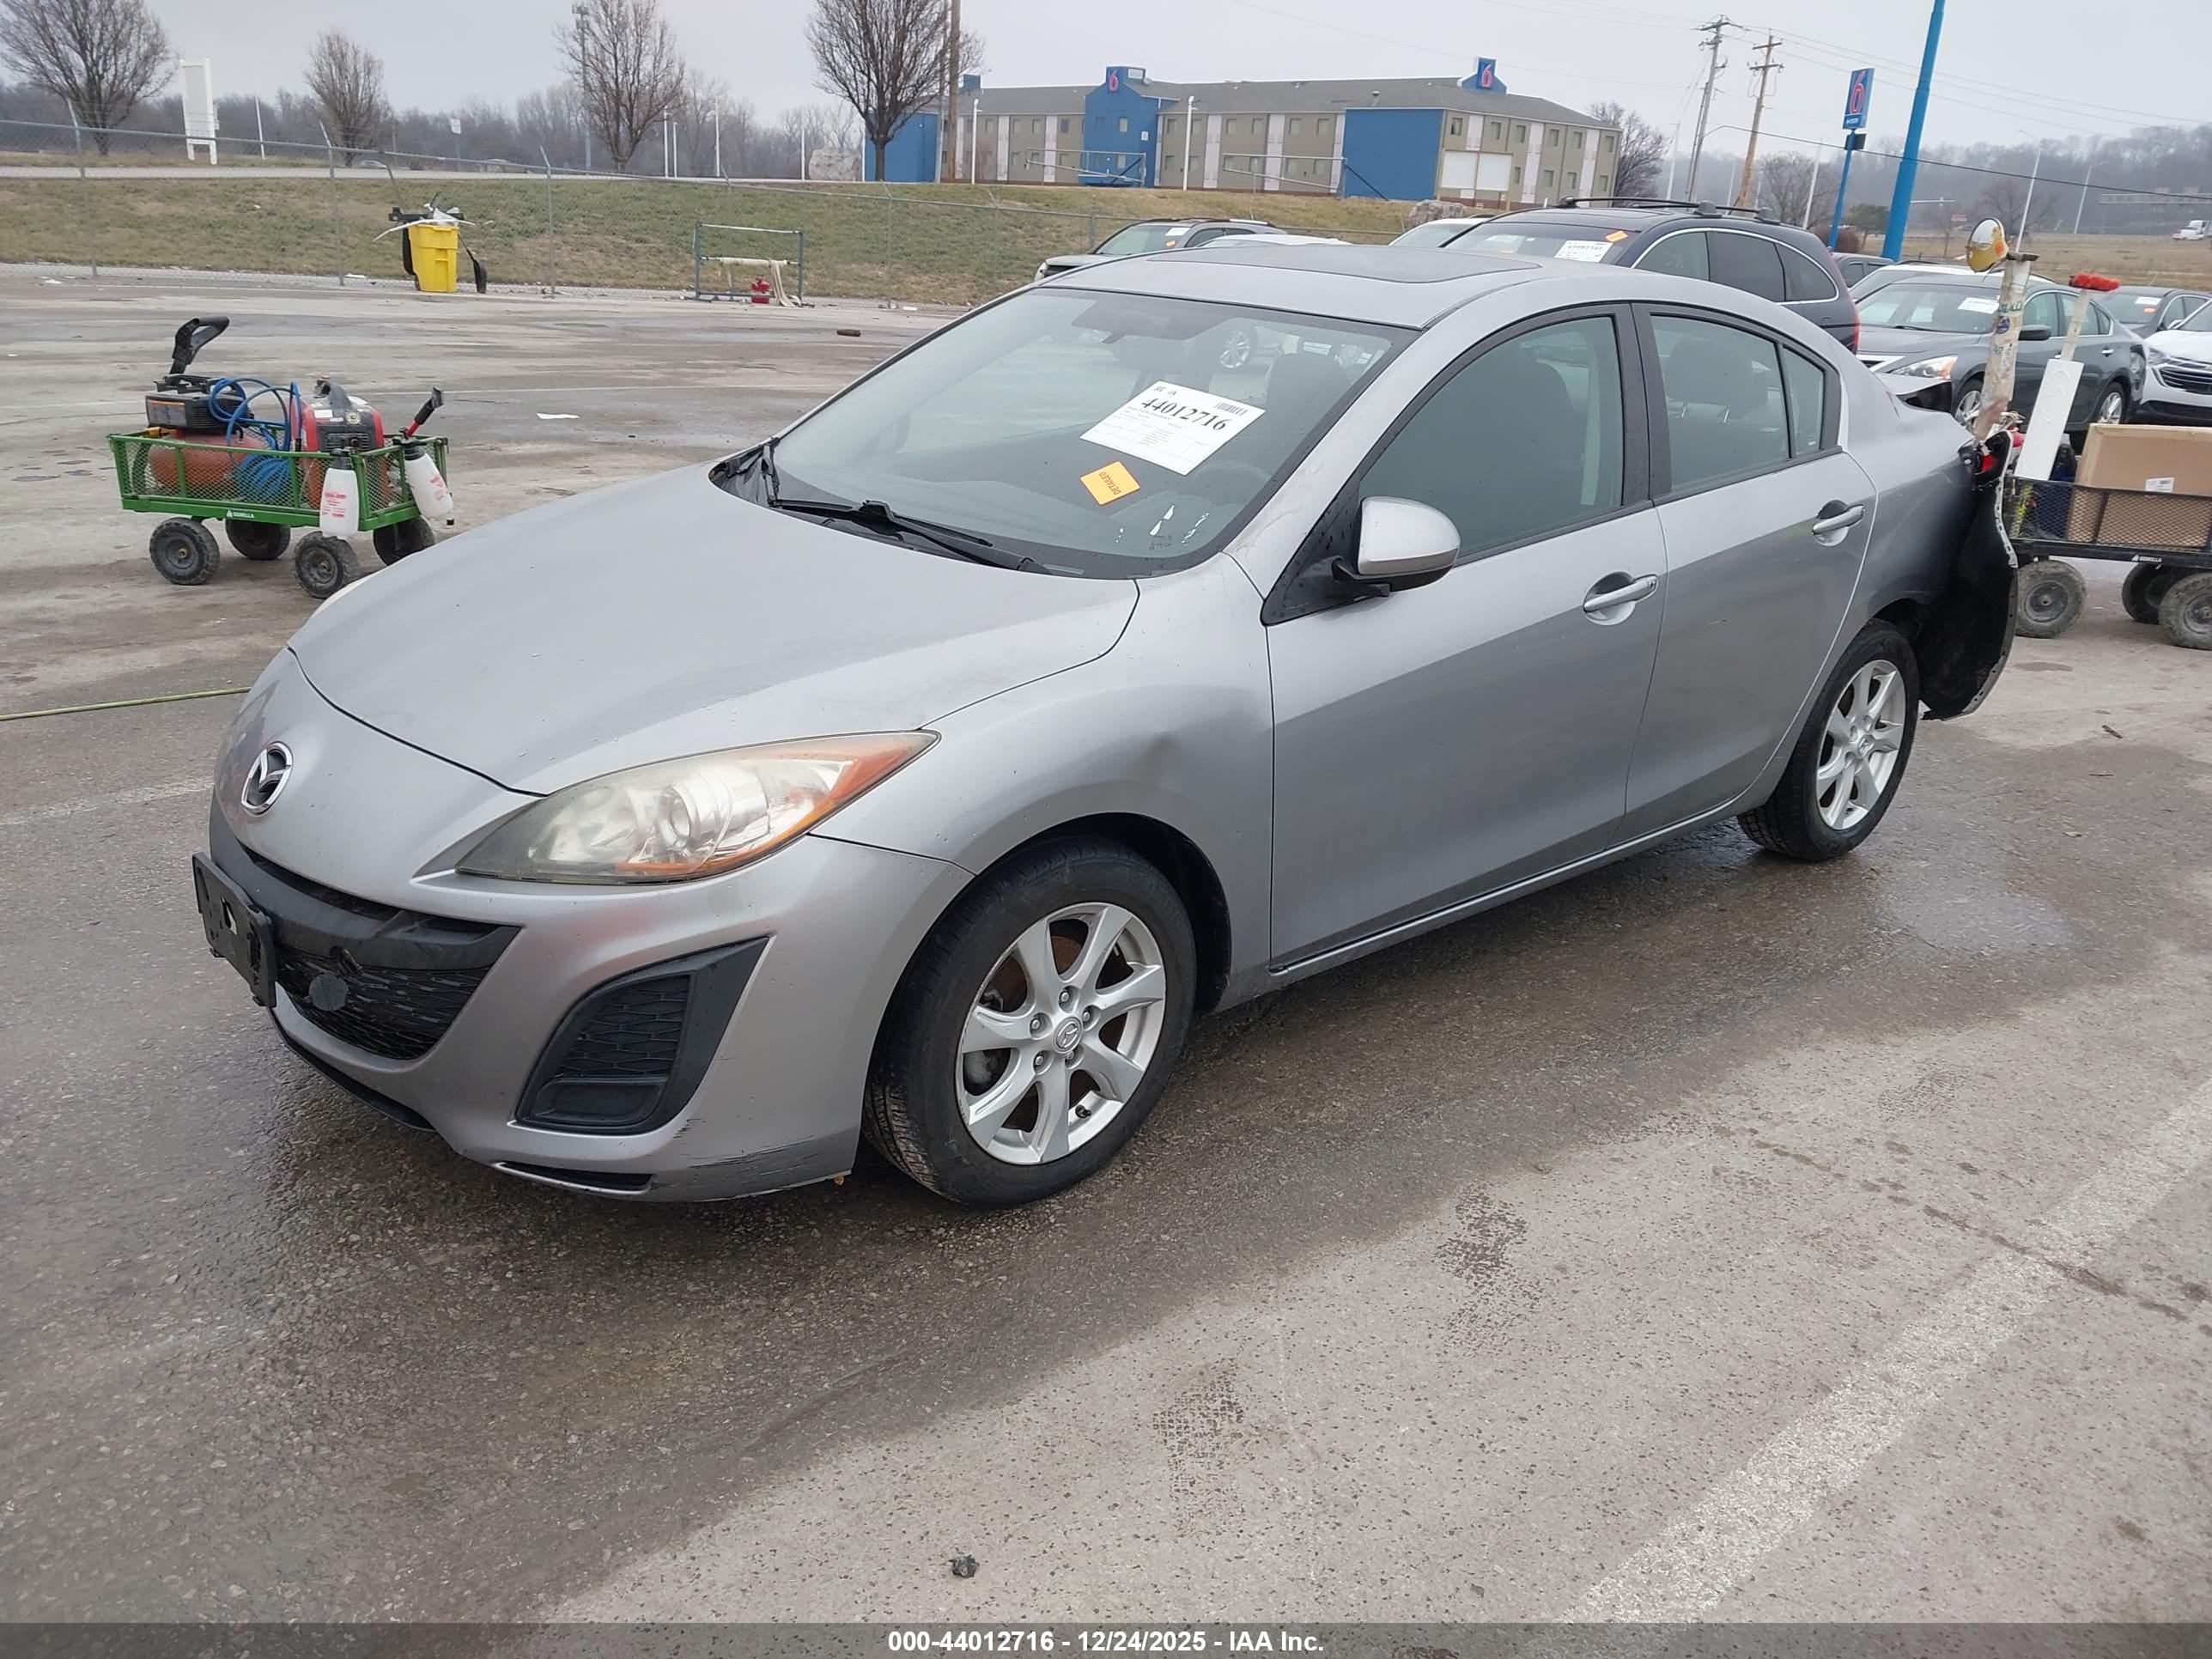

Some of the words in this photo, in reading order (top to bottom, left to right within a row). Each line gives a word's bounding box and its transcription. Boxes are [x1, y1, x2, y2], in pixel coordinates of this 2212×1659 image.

[1108, 70, 1119, 92] 6
[1481, 64, 1492, 88] 6
[1850, 70, 1867, 114] 6
[1141, 398, 1233, 431] 44012716
[1098, 471, 1122, 495] DETAILED
